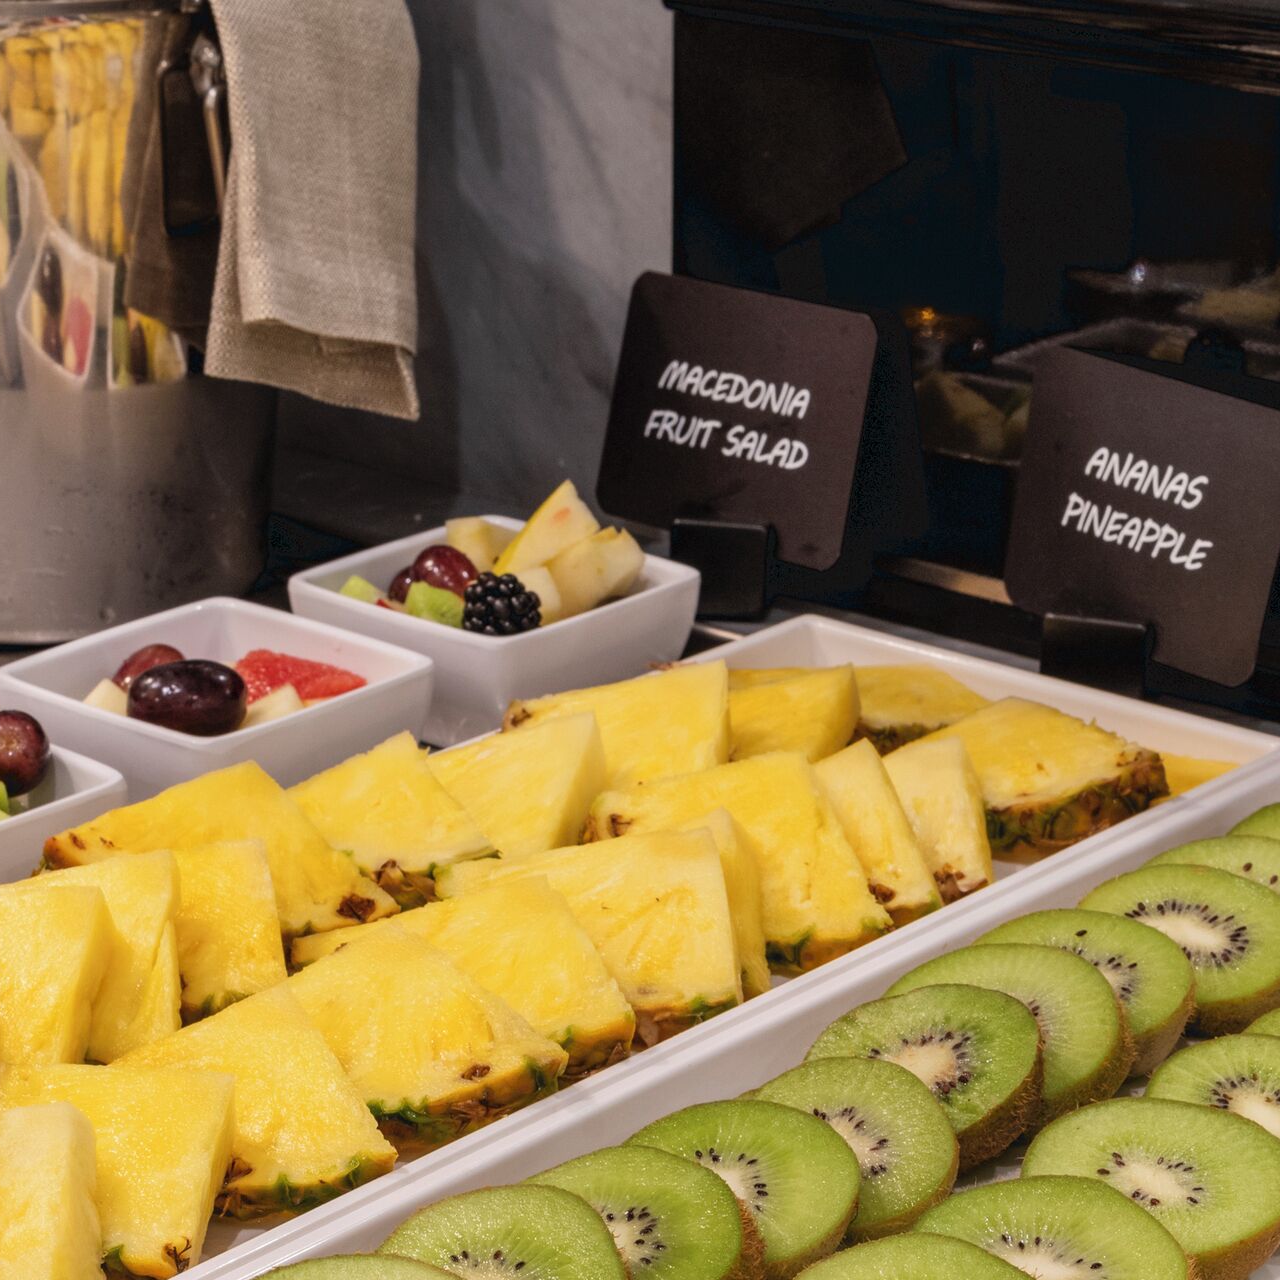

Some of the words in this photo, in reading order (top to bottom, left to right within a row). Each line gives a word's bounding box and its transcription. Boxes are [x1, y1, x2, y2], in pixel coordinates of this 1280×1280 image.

[659, 362, 811, 418] MACEDONIA
[645, 410, 723, 448] FRUIT
[722, 425, 811, 470] SALAD
[1085, 447, 1210, 510] ANANAS
[1061, 492, 1214, 571] PINEAPPLE
